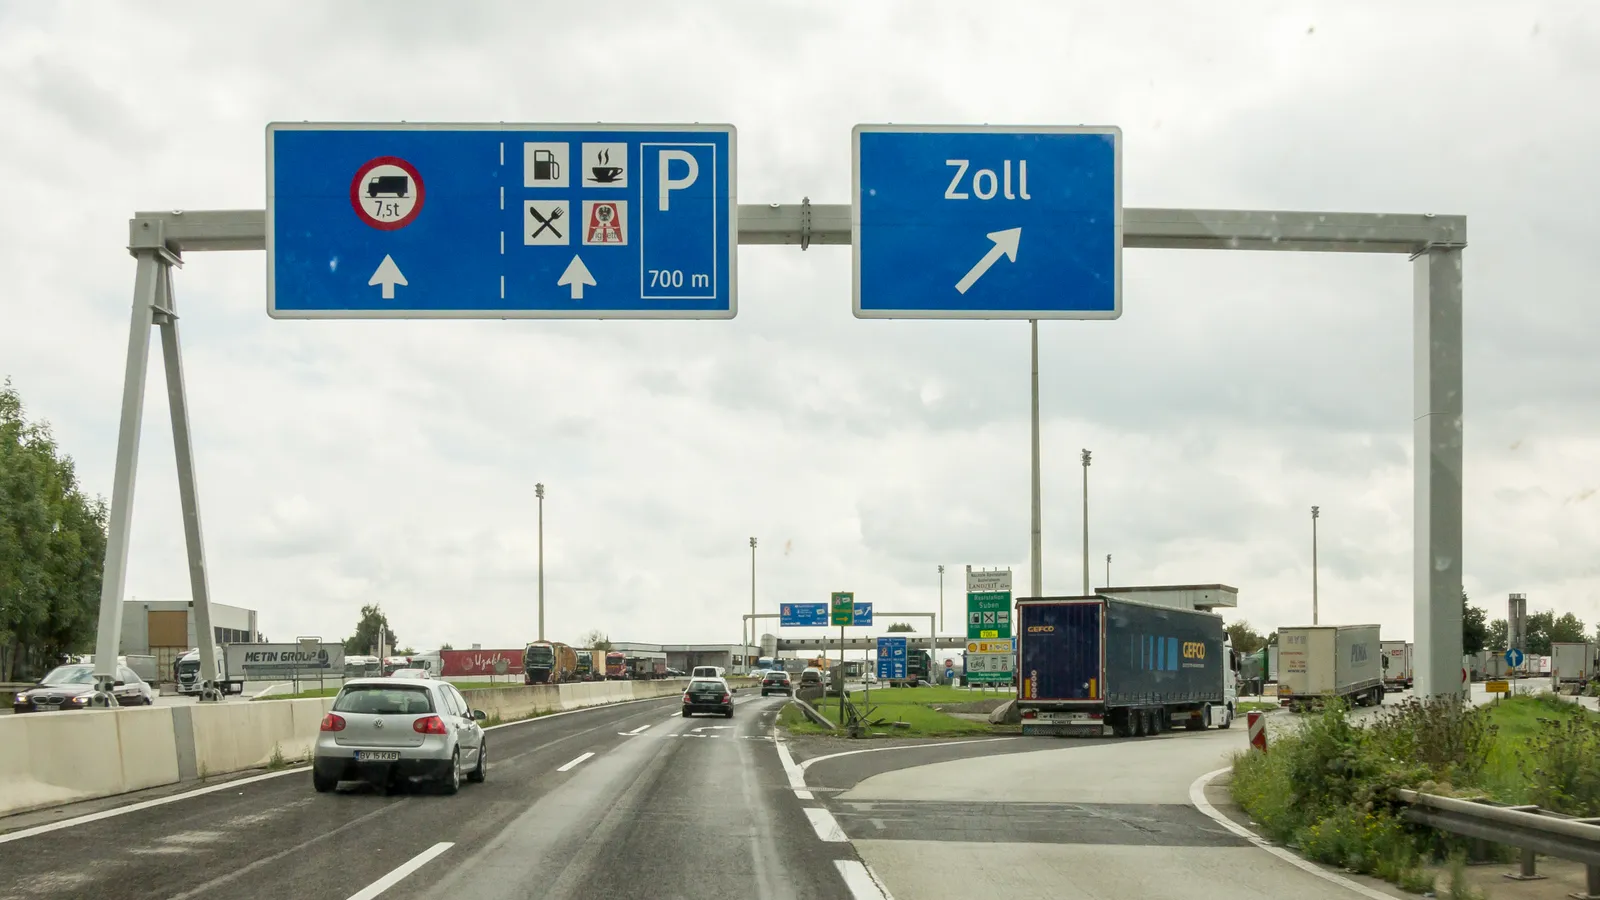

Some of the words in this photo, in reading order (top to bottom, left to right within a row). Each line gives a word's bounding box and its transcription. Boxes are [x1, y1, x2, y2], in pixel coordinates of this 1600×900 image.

[659, 150, 699, 211] P
[944, 160, 1031, 200] Zoll
[648, 270, 684, 288] 700
[692, 274, 709, 288] m
[979, 601, 1000, 609] Suben
[280, 652, 317, 662] GROUP
[1183, 642, 1205, 659] GEFCO
[360, 752, 371, 760] BV
